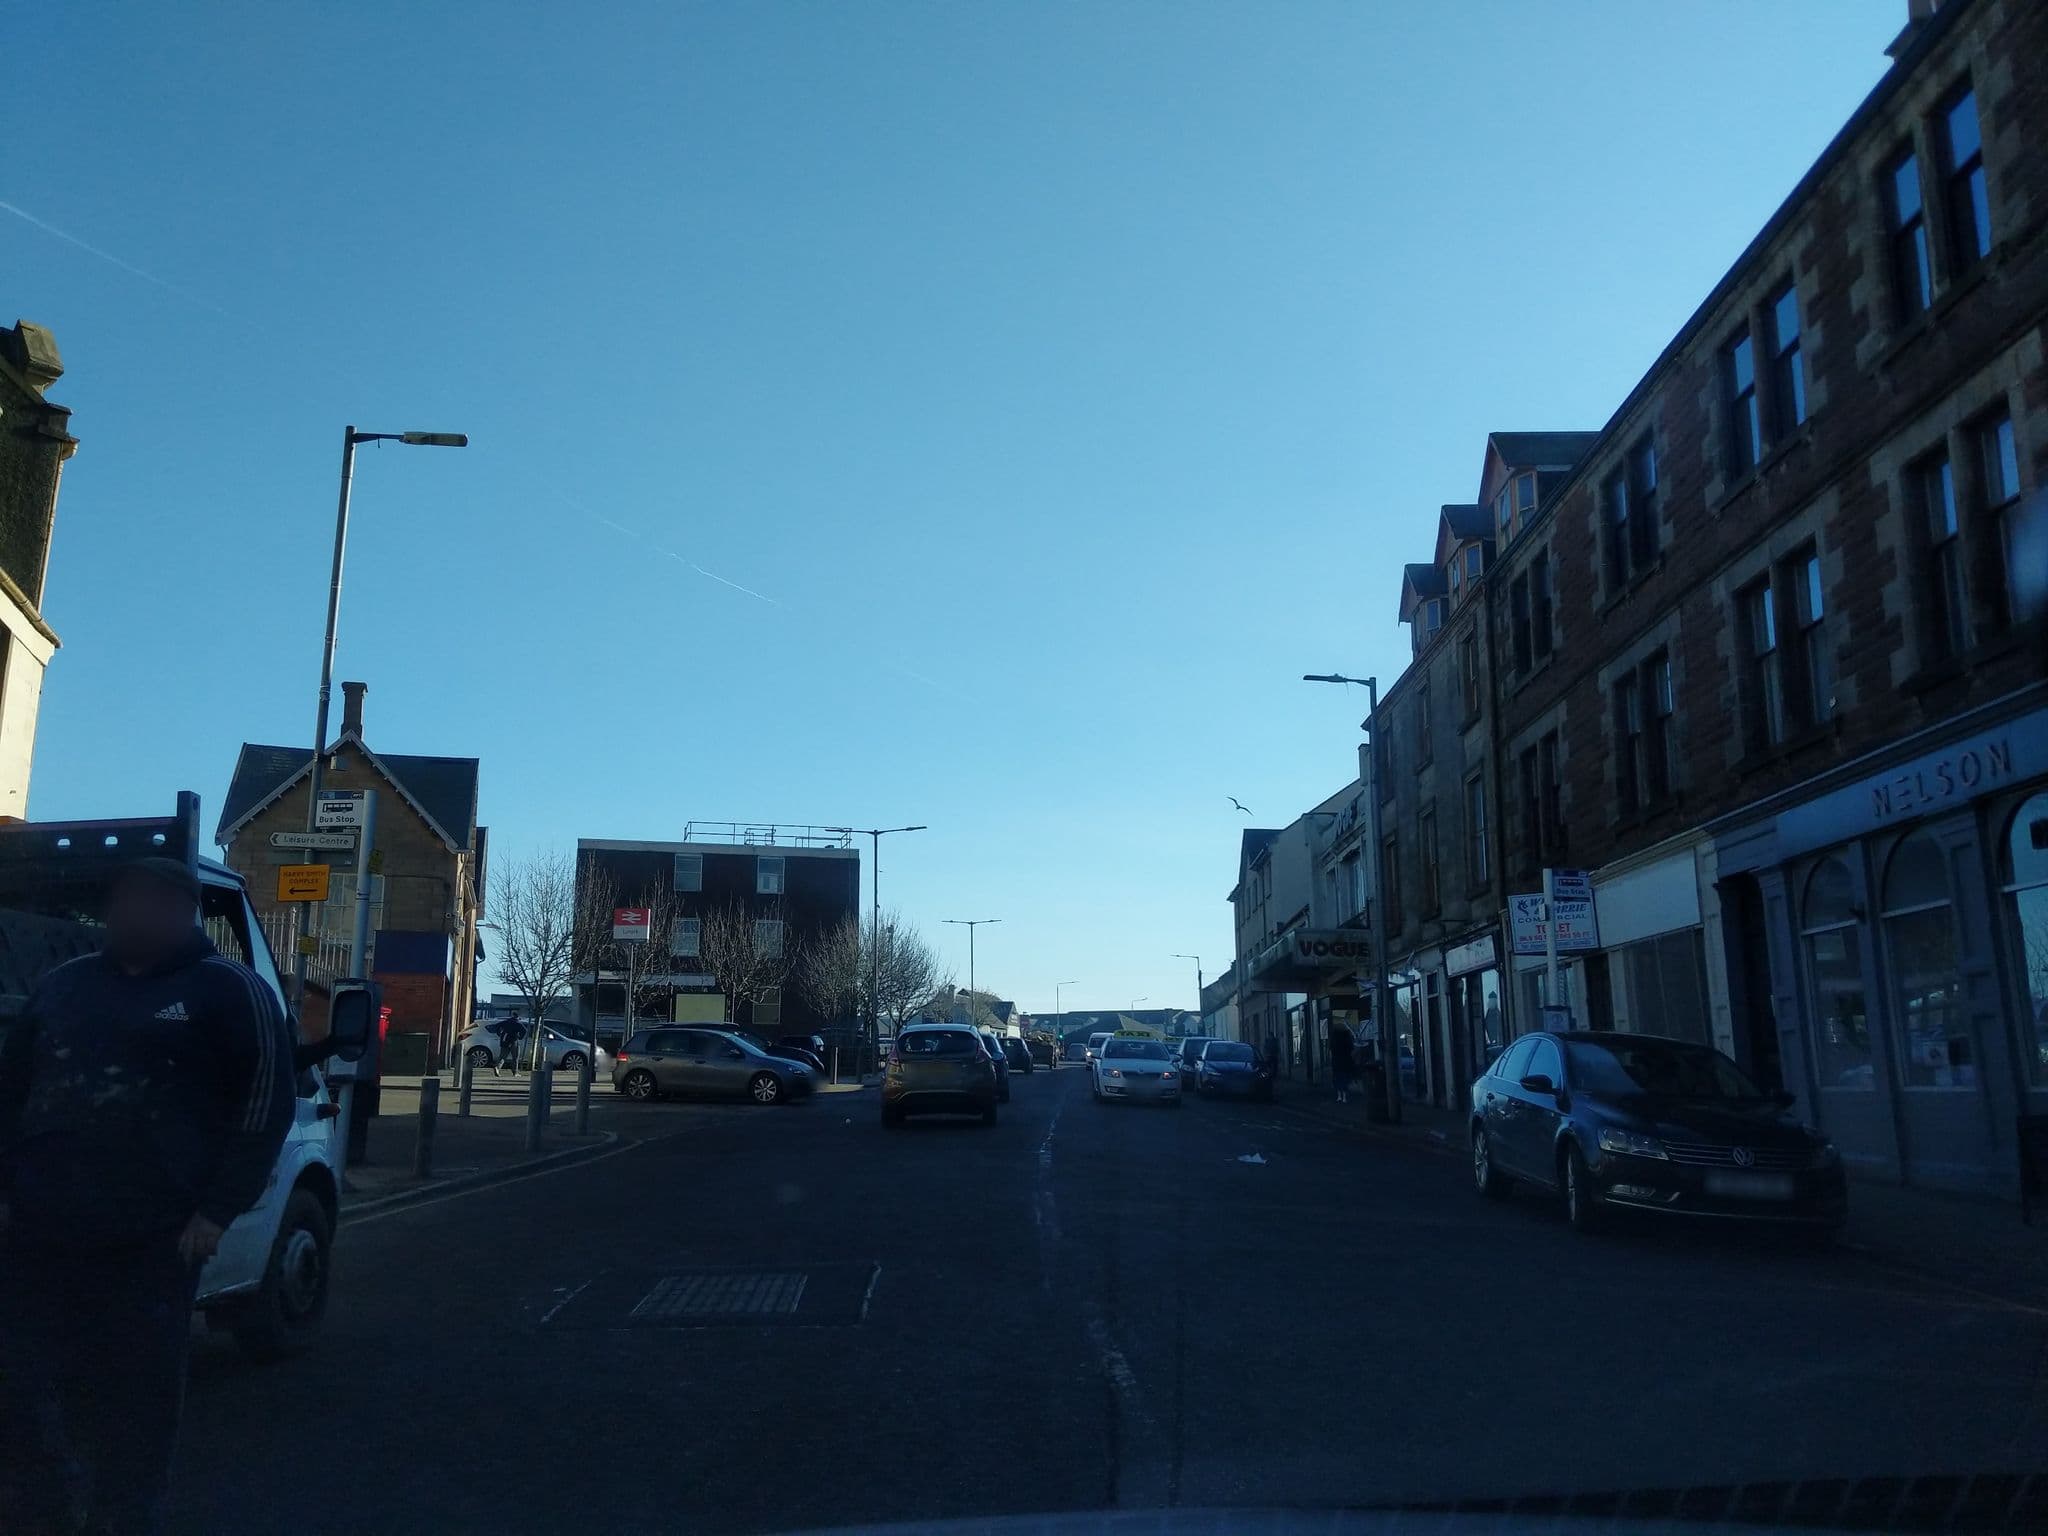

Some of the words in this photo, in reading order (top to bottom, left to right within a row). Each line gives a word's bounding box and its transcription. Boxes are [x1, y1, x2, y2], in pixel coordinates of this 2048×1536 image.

[1872, 738, 2012, 818] NELSON
[335, 815, 355, 824] Stop
[284, 835, 315, 843] Leisure
[320, 837, 349, 845] Centre
[1301, 939, 1369, 958] VOGUE
[154, 1010, 190, 1021] adidas
